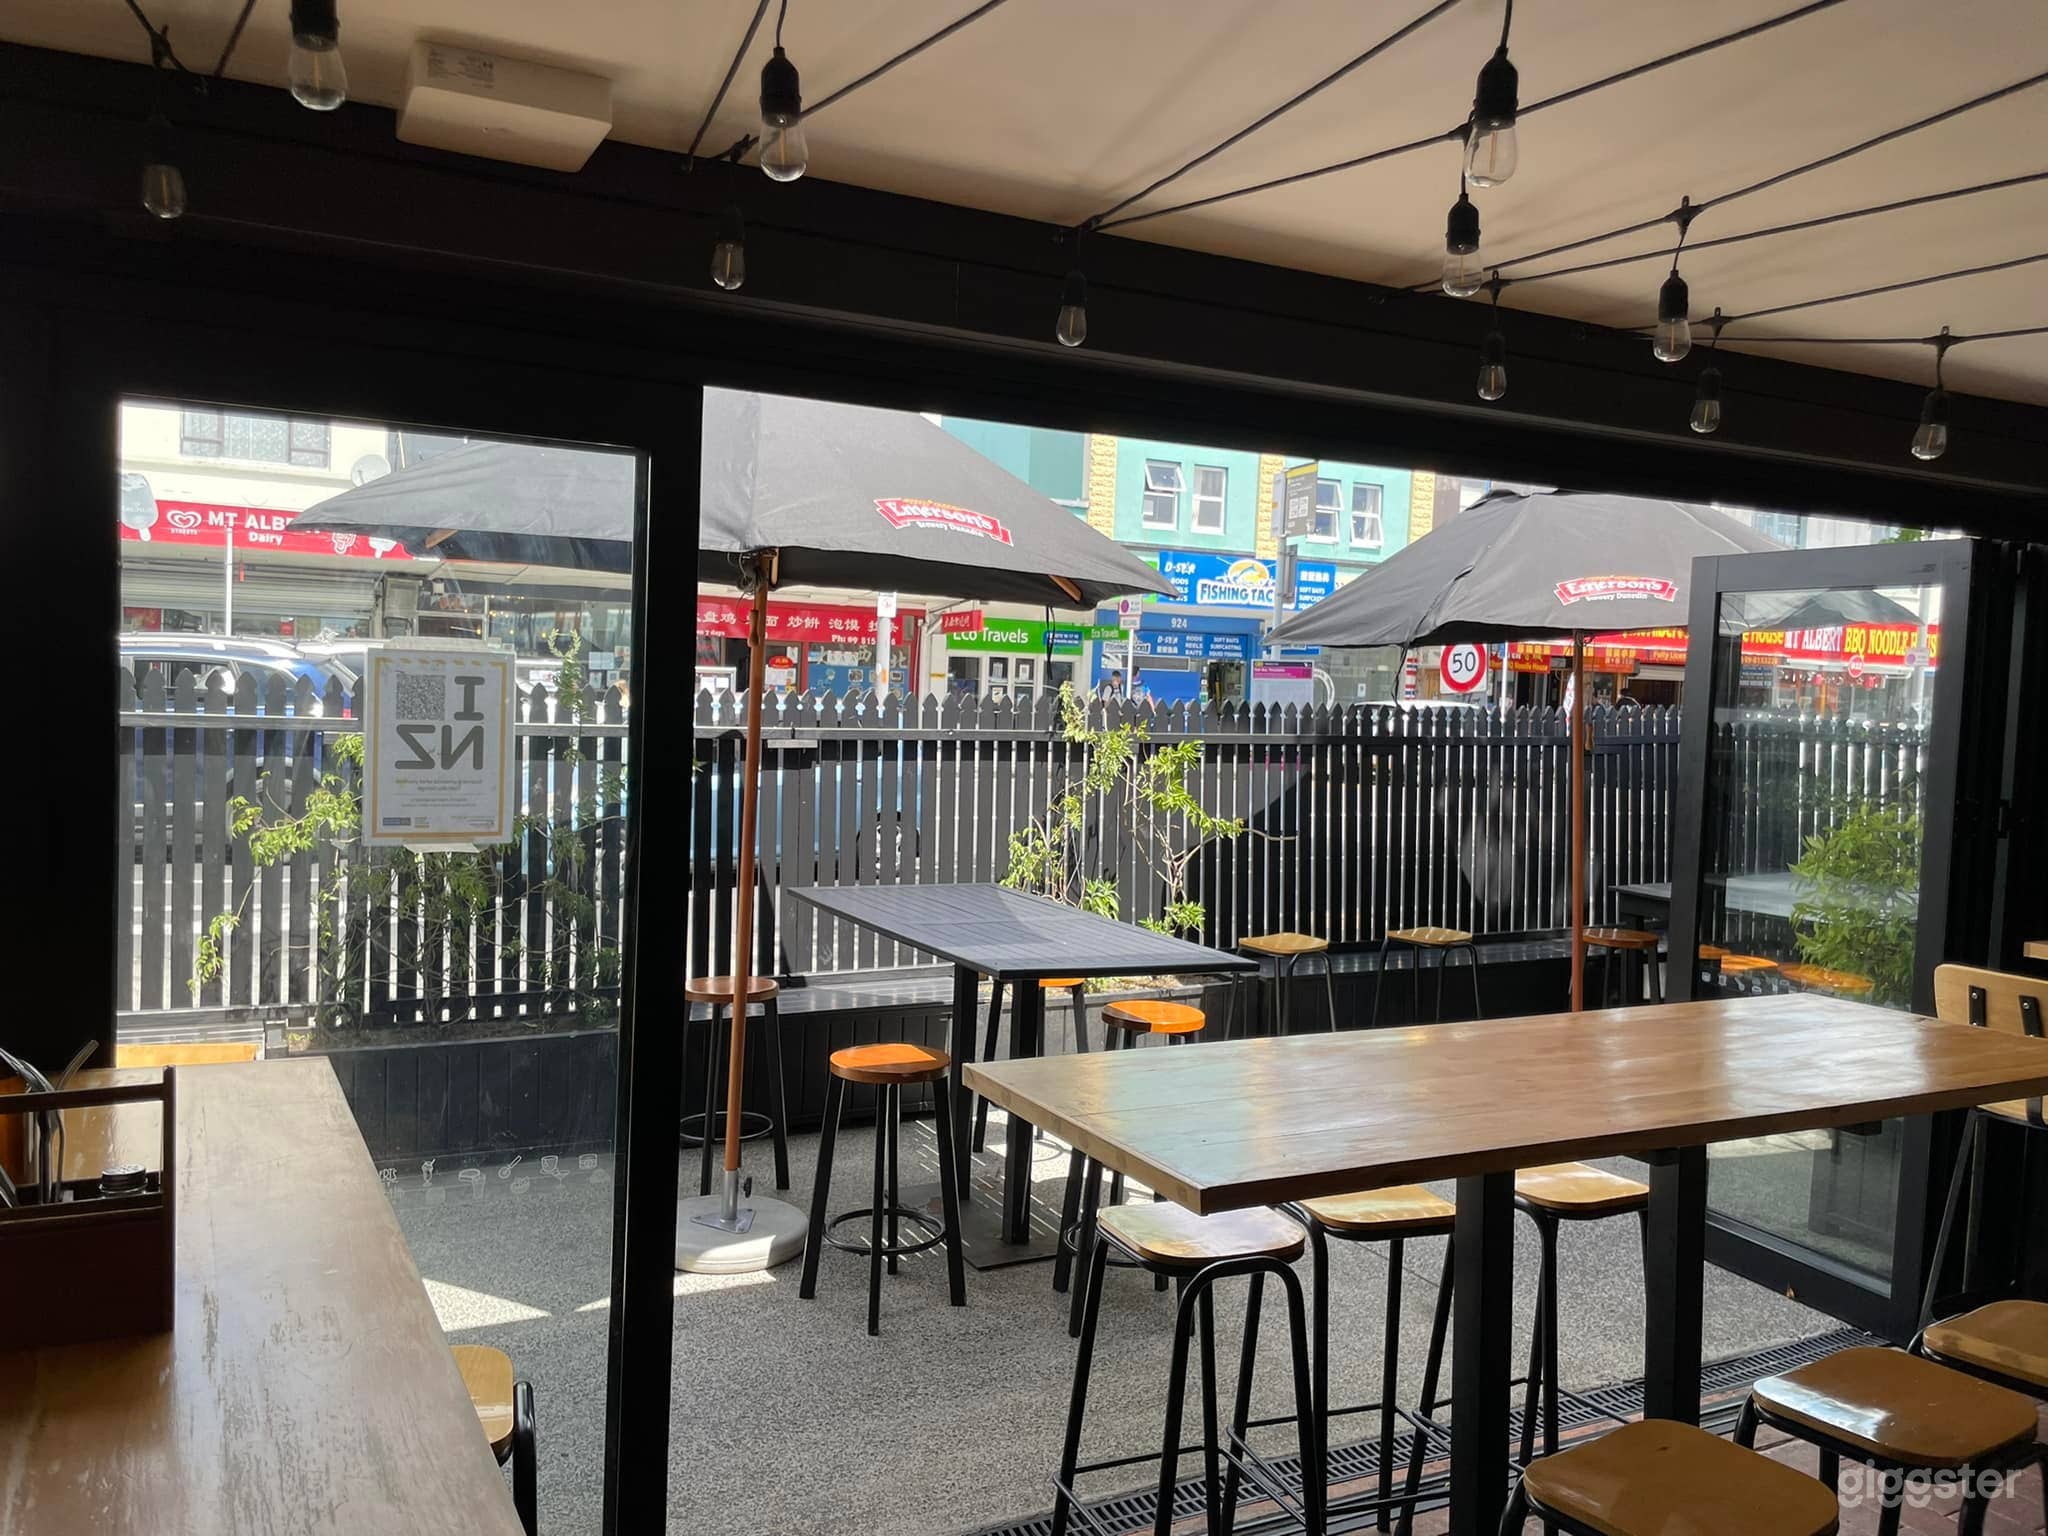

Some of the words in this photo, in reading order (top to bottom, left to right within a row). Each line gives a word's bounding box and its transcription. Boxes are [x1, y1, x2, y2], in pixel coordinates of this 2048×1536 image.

[208, 511, 238, 528] MT
[248, 531, 283, 546] Dairy
[1200, 583, 1249, 600] FISHING
[1250, 588, 1275, 602] TAC
[1565, 579, 1662, 595] Emerson's
[697, 610, 737, 625] 盘鸡
[1171, 618, 1187, 629] 924
[953, 629, 978, 641] Eco
[982, 627, 1029, 644] Travels
[1802, 627, 1842, 651] ALBERT
[1844, 627, 1867, 657] BBQ
[1452, 652, 1476, 673] 50
